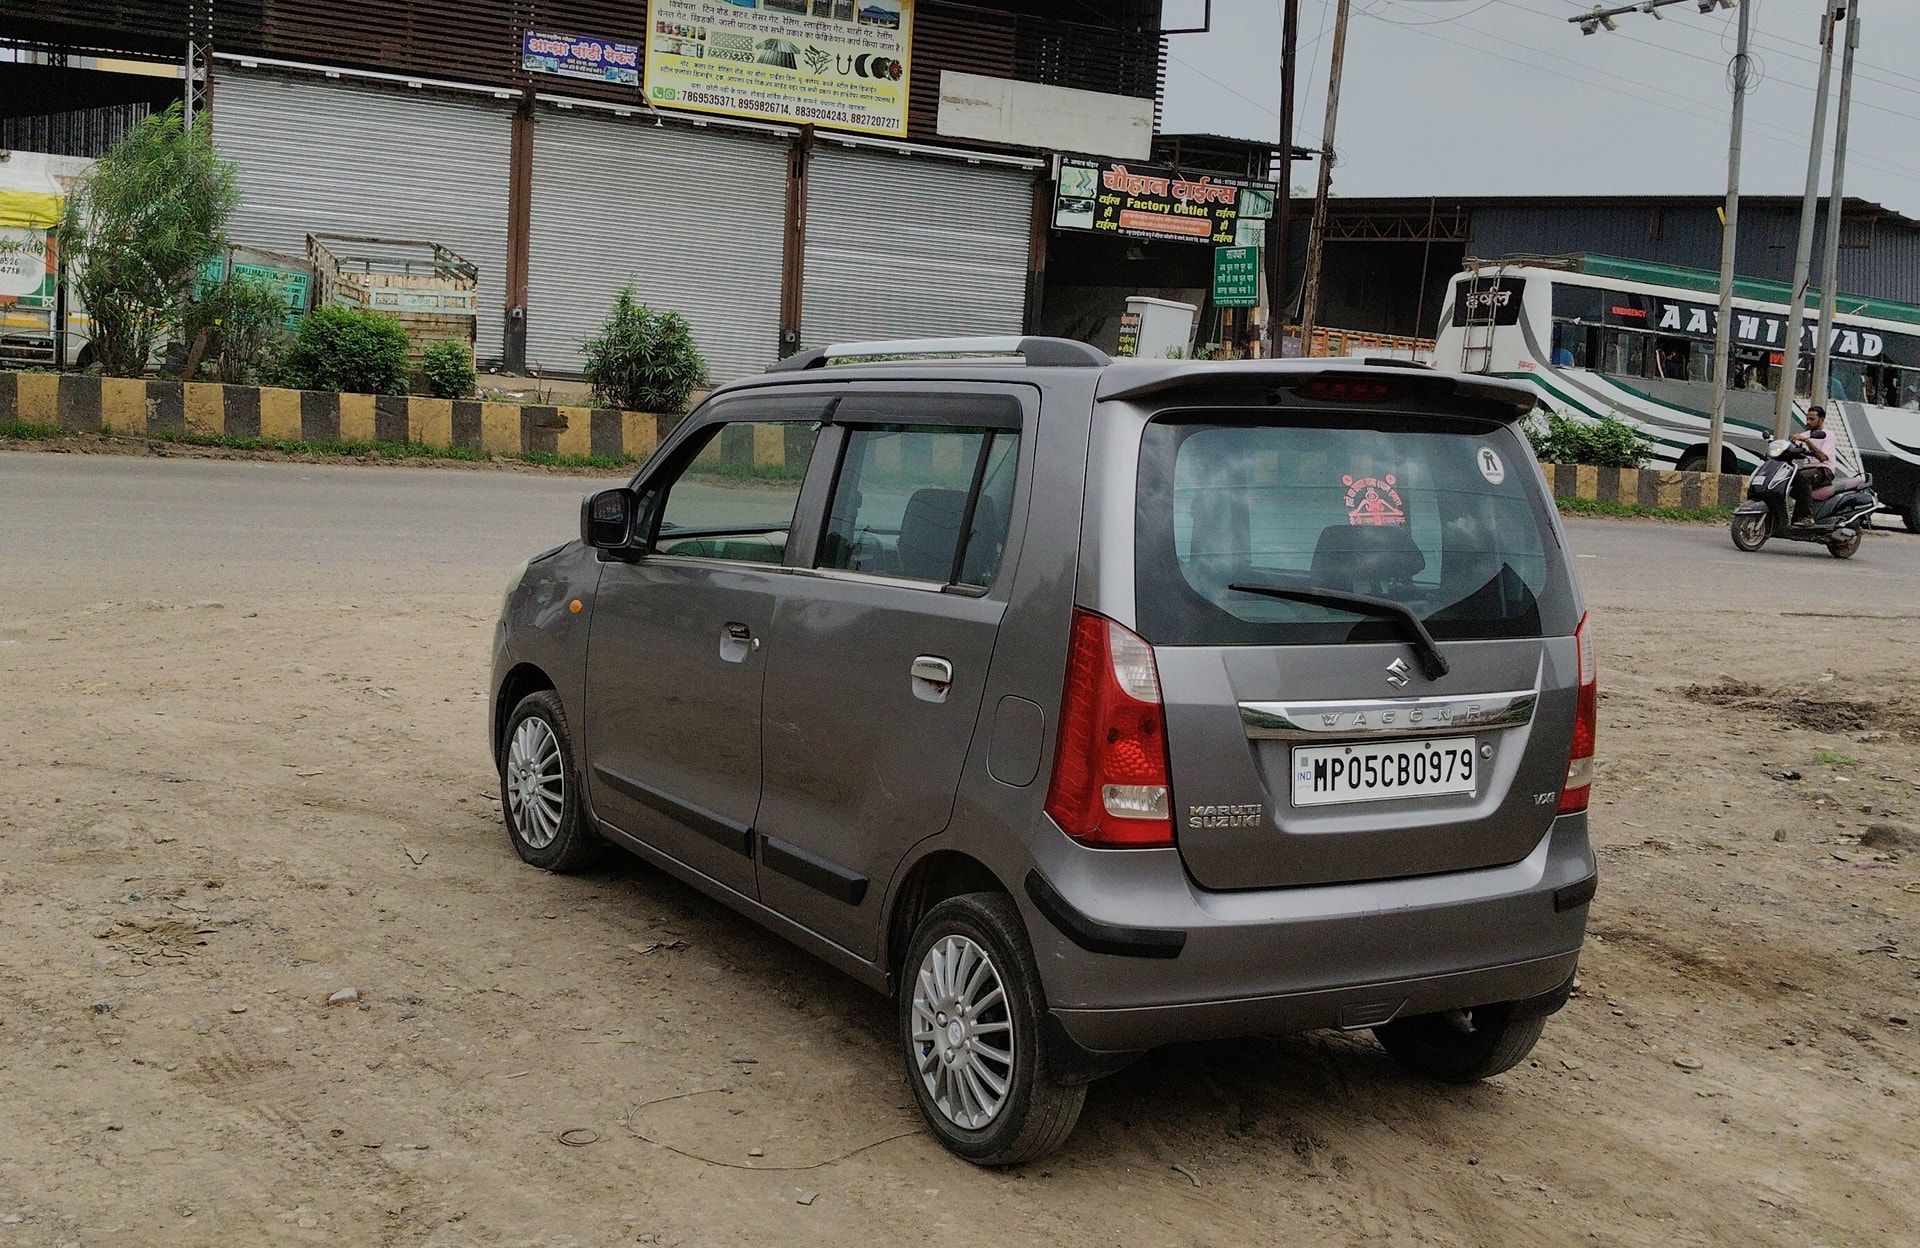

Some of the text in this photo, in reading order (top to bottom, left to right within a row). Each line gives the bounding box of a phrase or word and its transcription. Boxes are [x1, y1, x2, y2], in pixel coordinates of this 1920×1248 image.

[851, 113, 900, 129] 8827207271
[1102, 164, 1237, 204] चौहान टाईल्स
[1099, 194, 1121, 206] टाईल्स
[1104, 206, 1113, 218] ही
[1126, 198, 1208, 217] Factory Outlet
[1215, 207, 1236, 219] टाईल्स
[1096, 219, 1118, 230] टाईल्स
[1220, 220, 1229, 230] ही
[1212, 232, 1233, 243] टाईल्स
[1297, 771, 1311, 781] IND
[1313, 749, 1473, 792] MP05CB0979
[1188, 804, 1262, 816] MARUTI
[1188, 815, 1261, 829] SUZUKI
